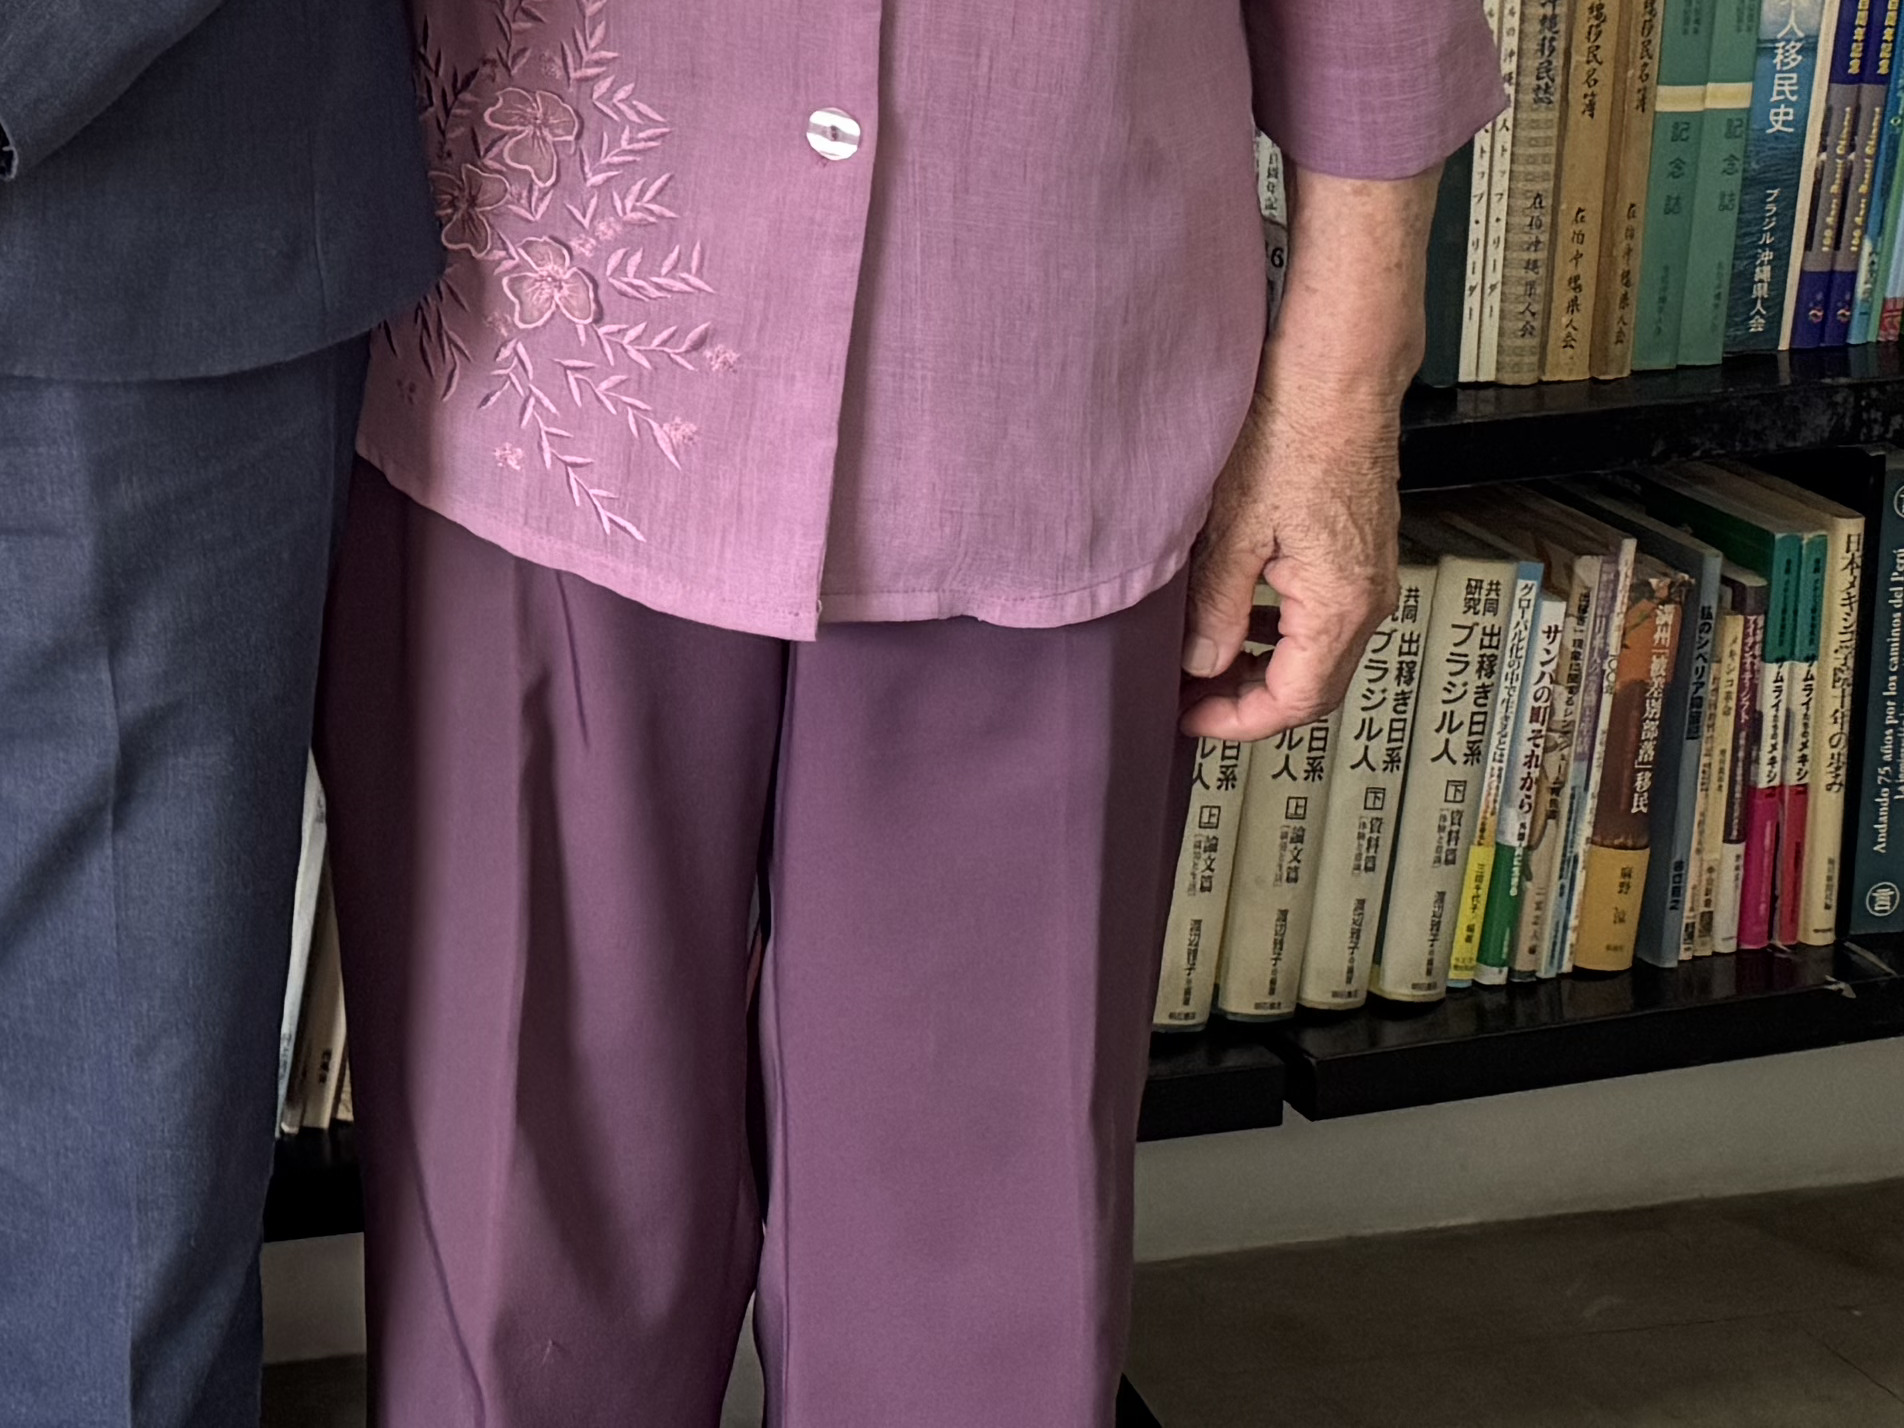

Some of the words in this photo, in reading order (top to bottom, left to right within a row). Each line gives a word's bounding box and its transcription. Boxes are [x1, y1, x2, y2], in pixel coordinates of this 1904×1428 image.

[1887, 615, 1903, 675] caminos
[1884, 679, 1899, 700] los
[1884, 705, 1897, 730] por
[1880, 734, 1894, 764] años
[1877, 766, 1891, 785] 75
[1873, 787, 1891, 854] Andando
